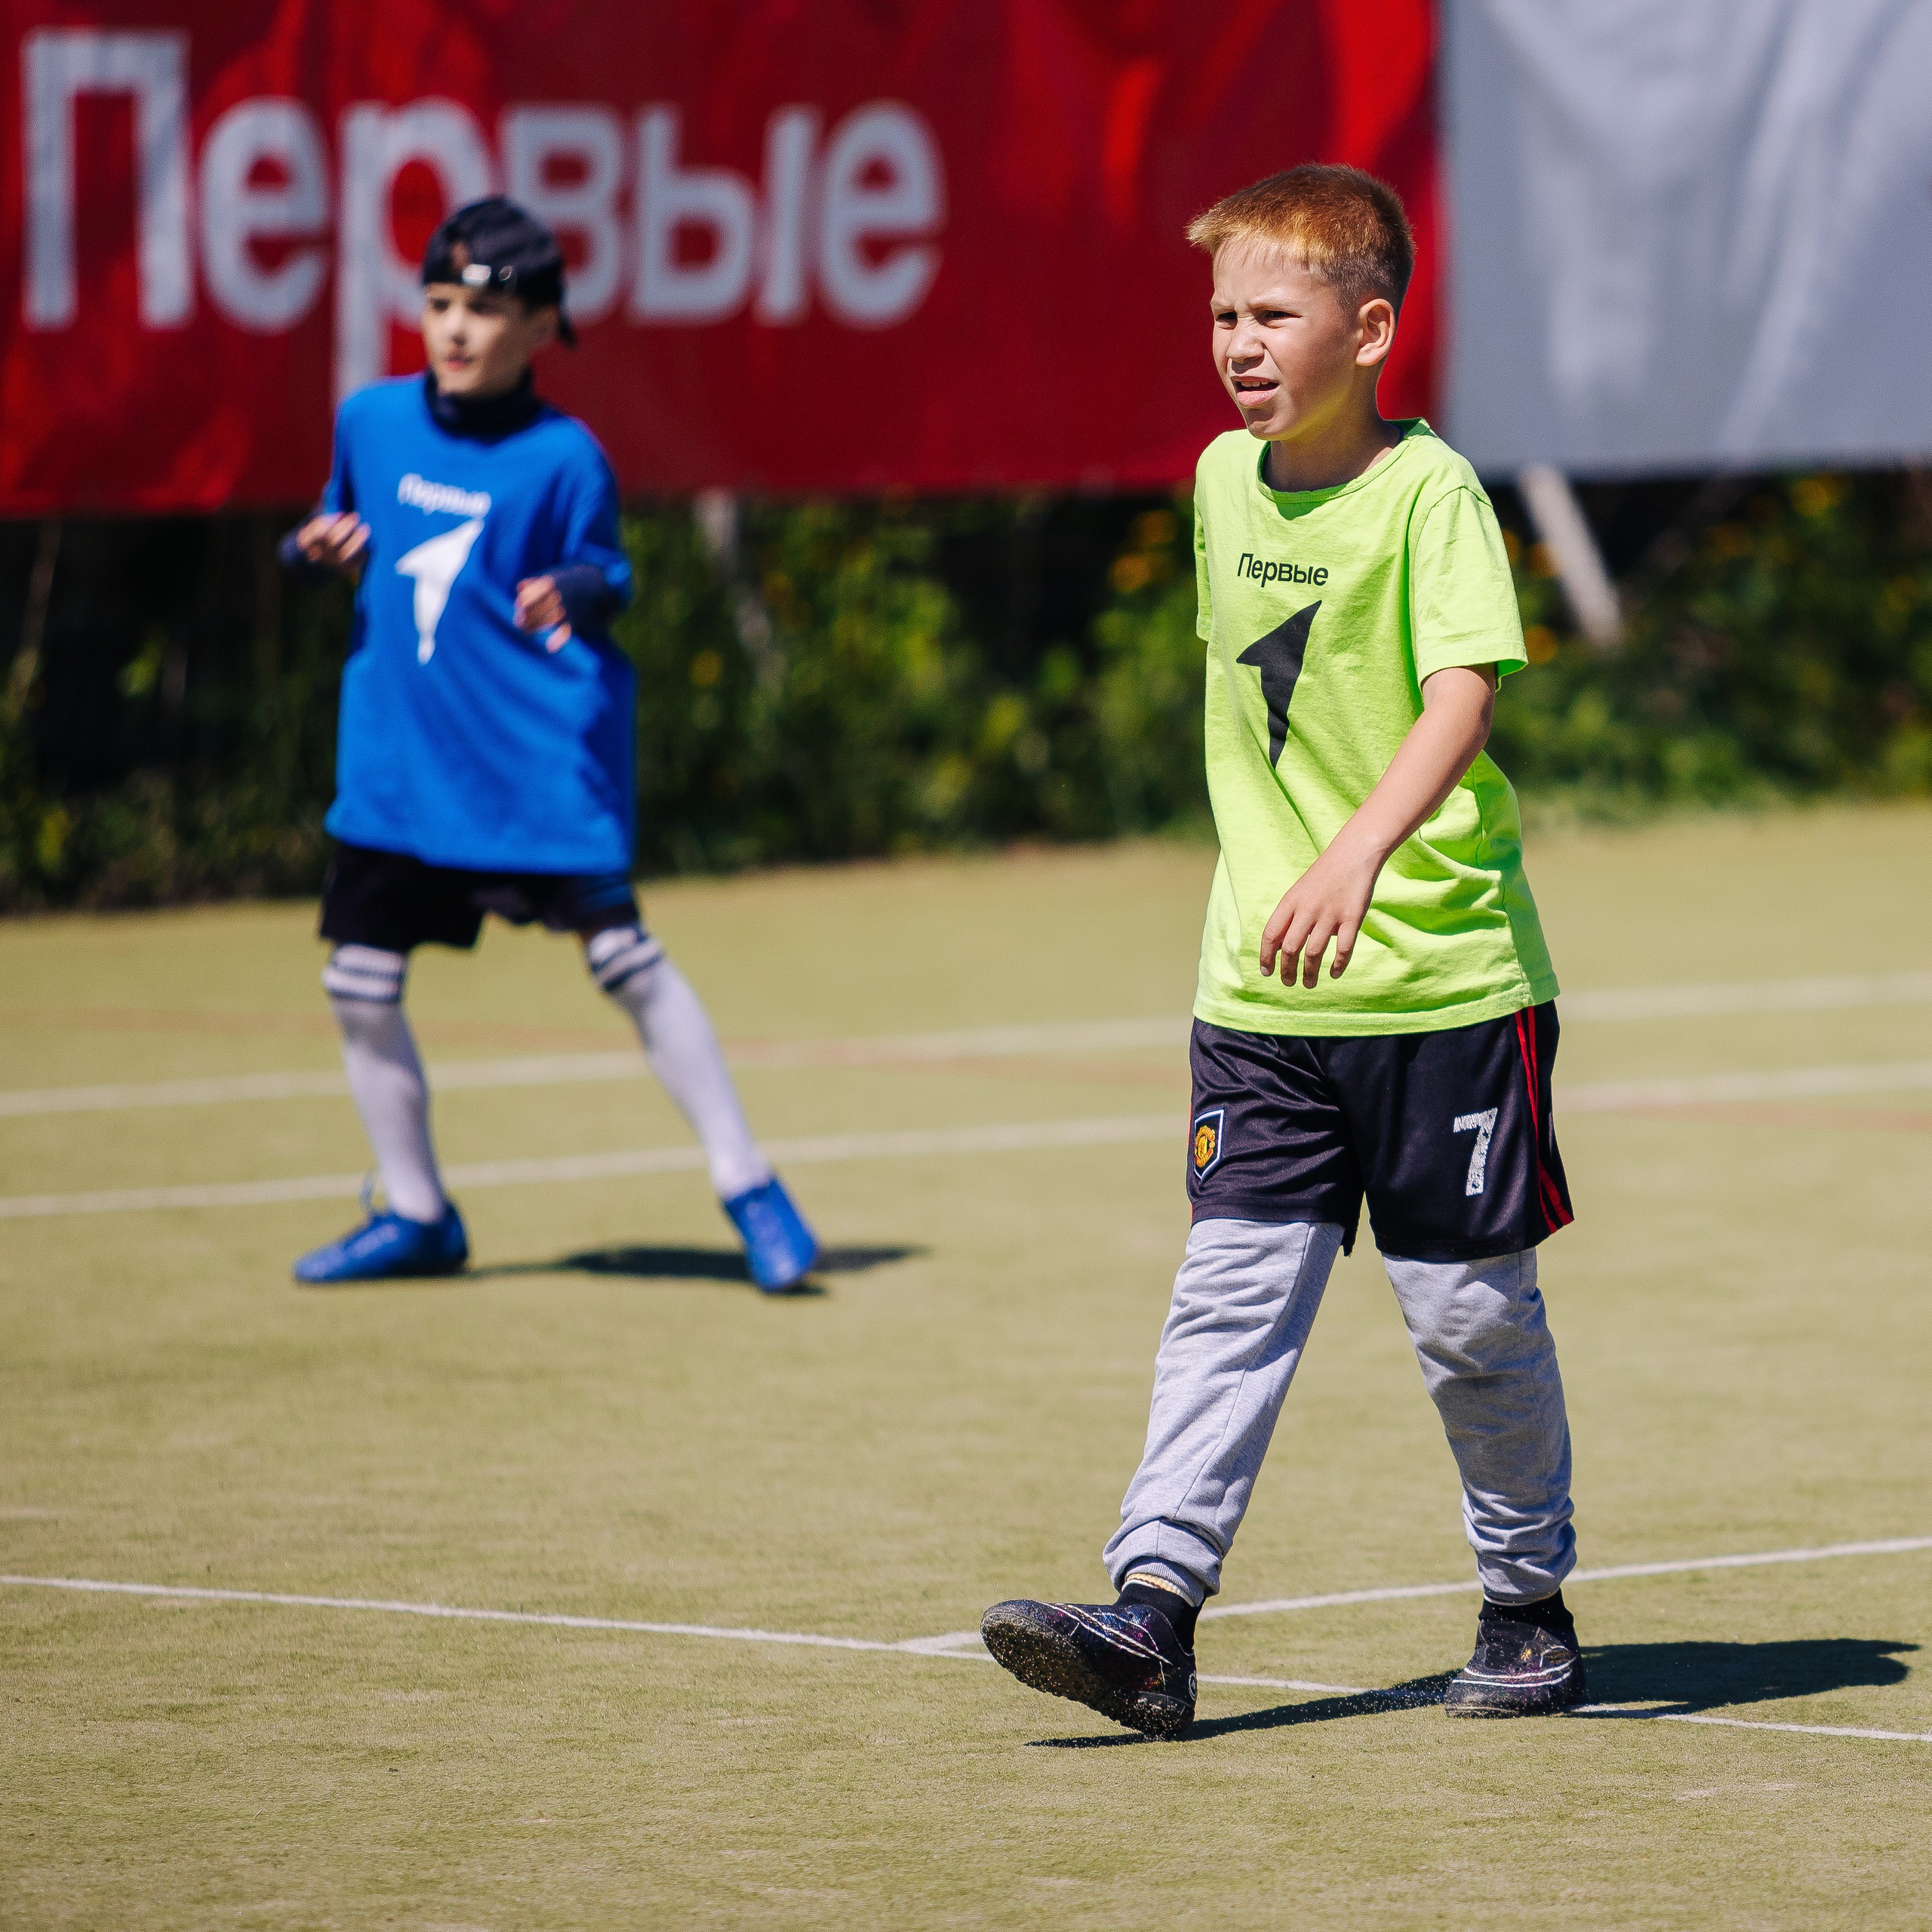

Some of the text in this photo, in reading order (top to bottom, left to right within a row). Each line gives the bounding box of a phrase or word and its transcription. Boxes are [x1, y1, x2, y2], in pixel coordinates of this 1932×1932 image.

[21, 29, 945, 394] Первые
[1237, 552, 1329, 588] Первые
[1453, 1107, 1498, 1196] 7
